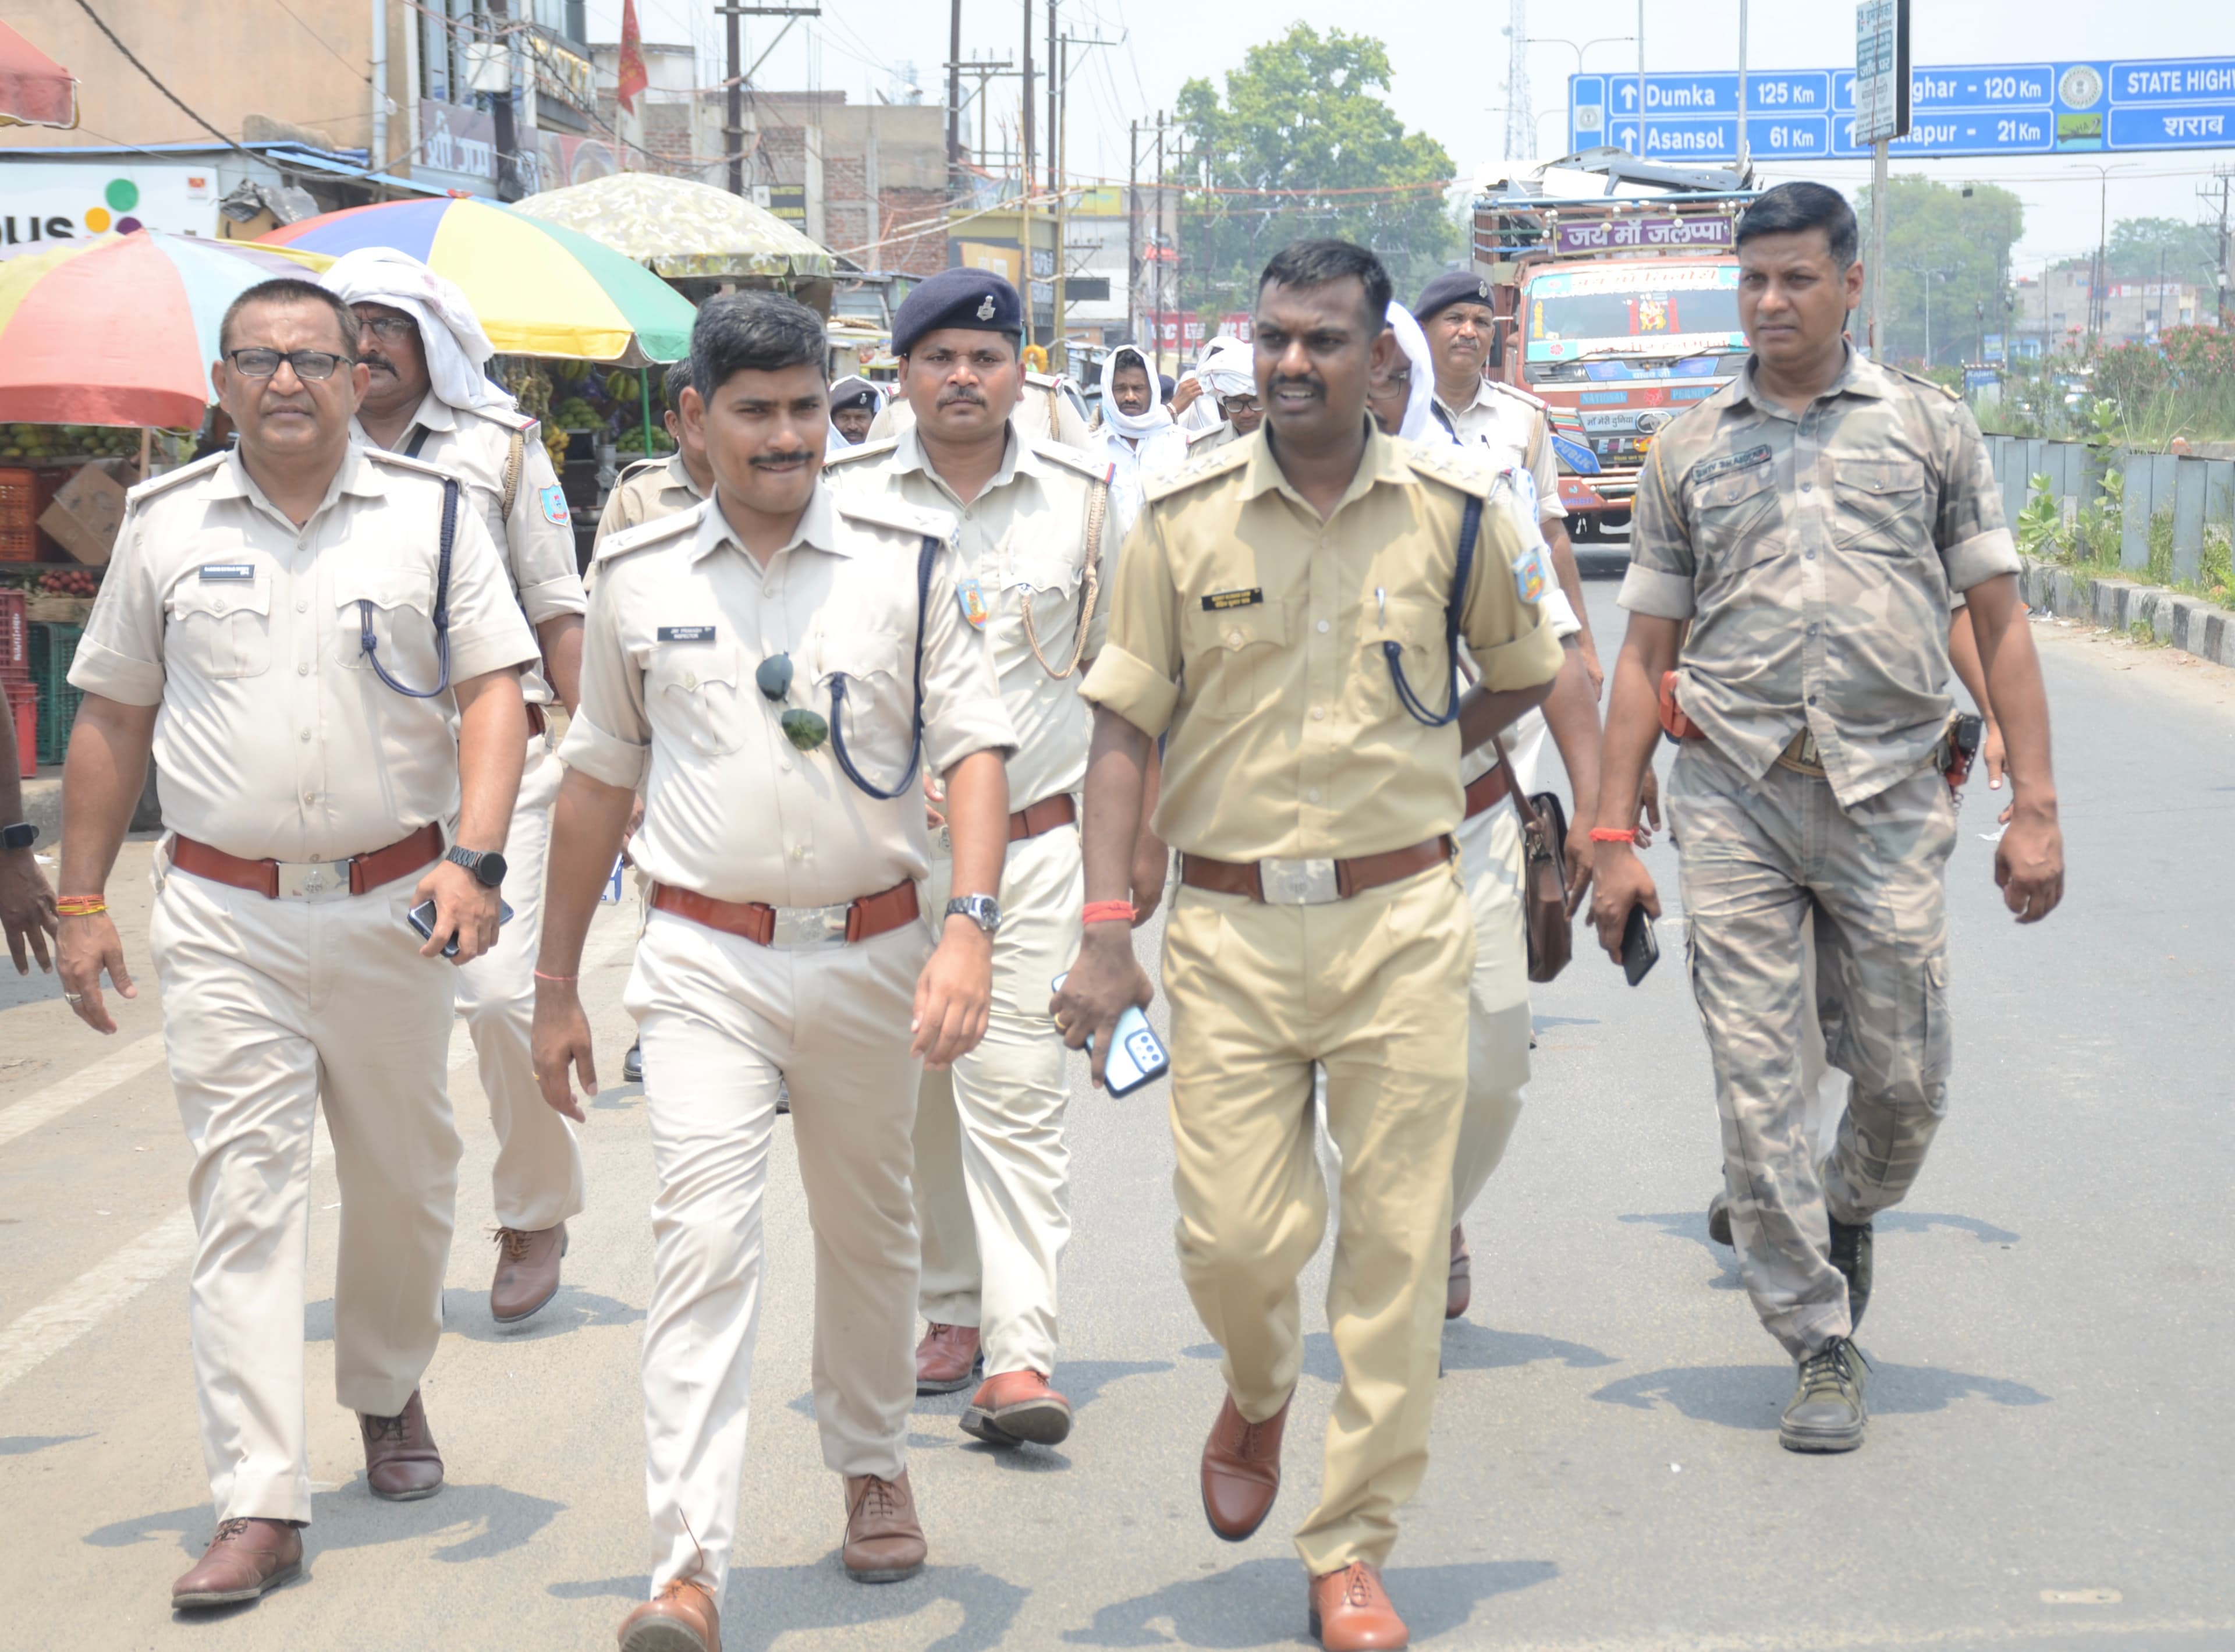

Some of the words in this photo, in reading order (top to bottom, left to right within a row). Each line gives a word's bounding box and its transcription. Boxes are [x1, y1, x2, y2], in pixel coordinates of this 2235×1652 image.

[1913, 76, 1957, 103] ghar
[1984, 77, 2016, 99] 120
[2020, 80, 2042, 98] Km
[2127, 71, 2182, 94] STATE
[1646, 84, 1716, 107] Dumka
[1758, 83, 1788, 105] 125
[1793, 86, 1815, 104] Km
[1998, 120, 2016, 141] 21
[2018, 123, 2041, 141] Km
[2163, 115, 2225, 137] शराब
[1647, 127, 1725, 150] Asansol
[1770, 126, 1789, 148] 61
[1793, 129, 1814, 147] Km
[1567, 225, 1609, 246] जय
[1553, 439, 1594, 470] PUBLIC
